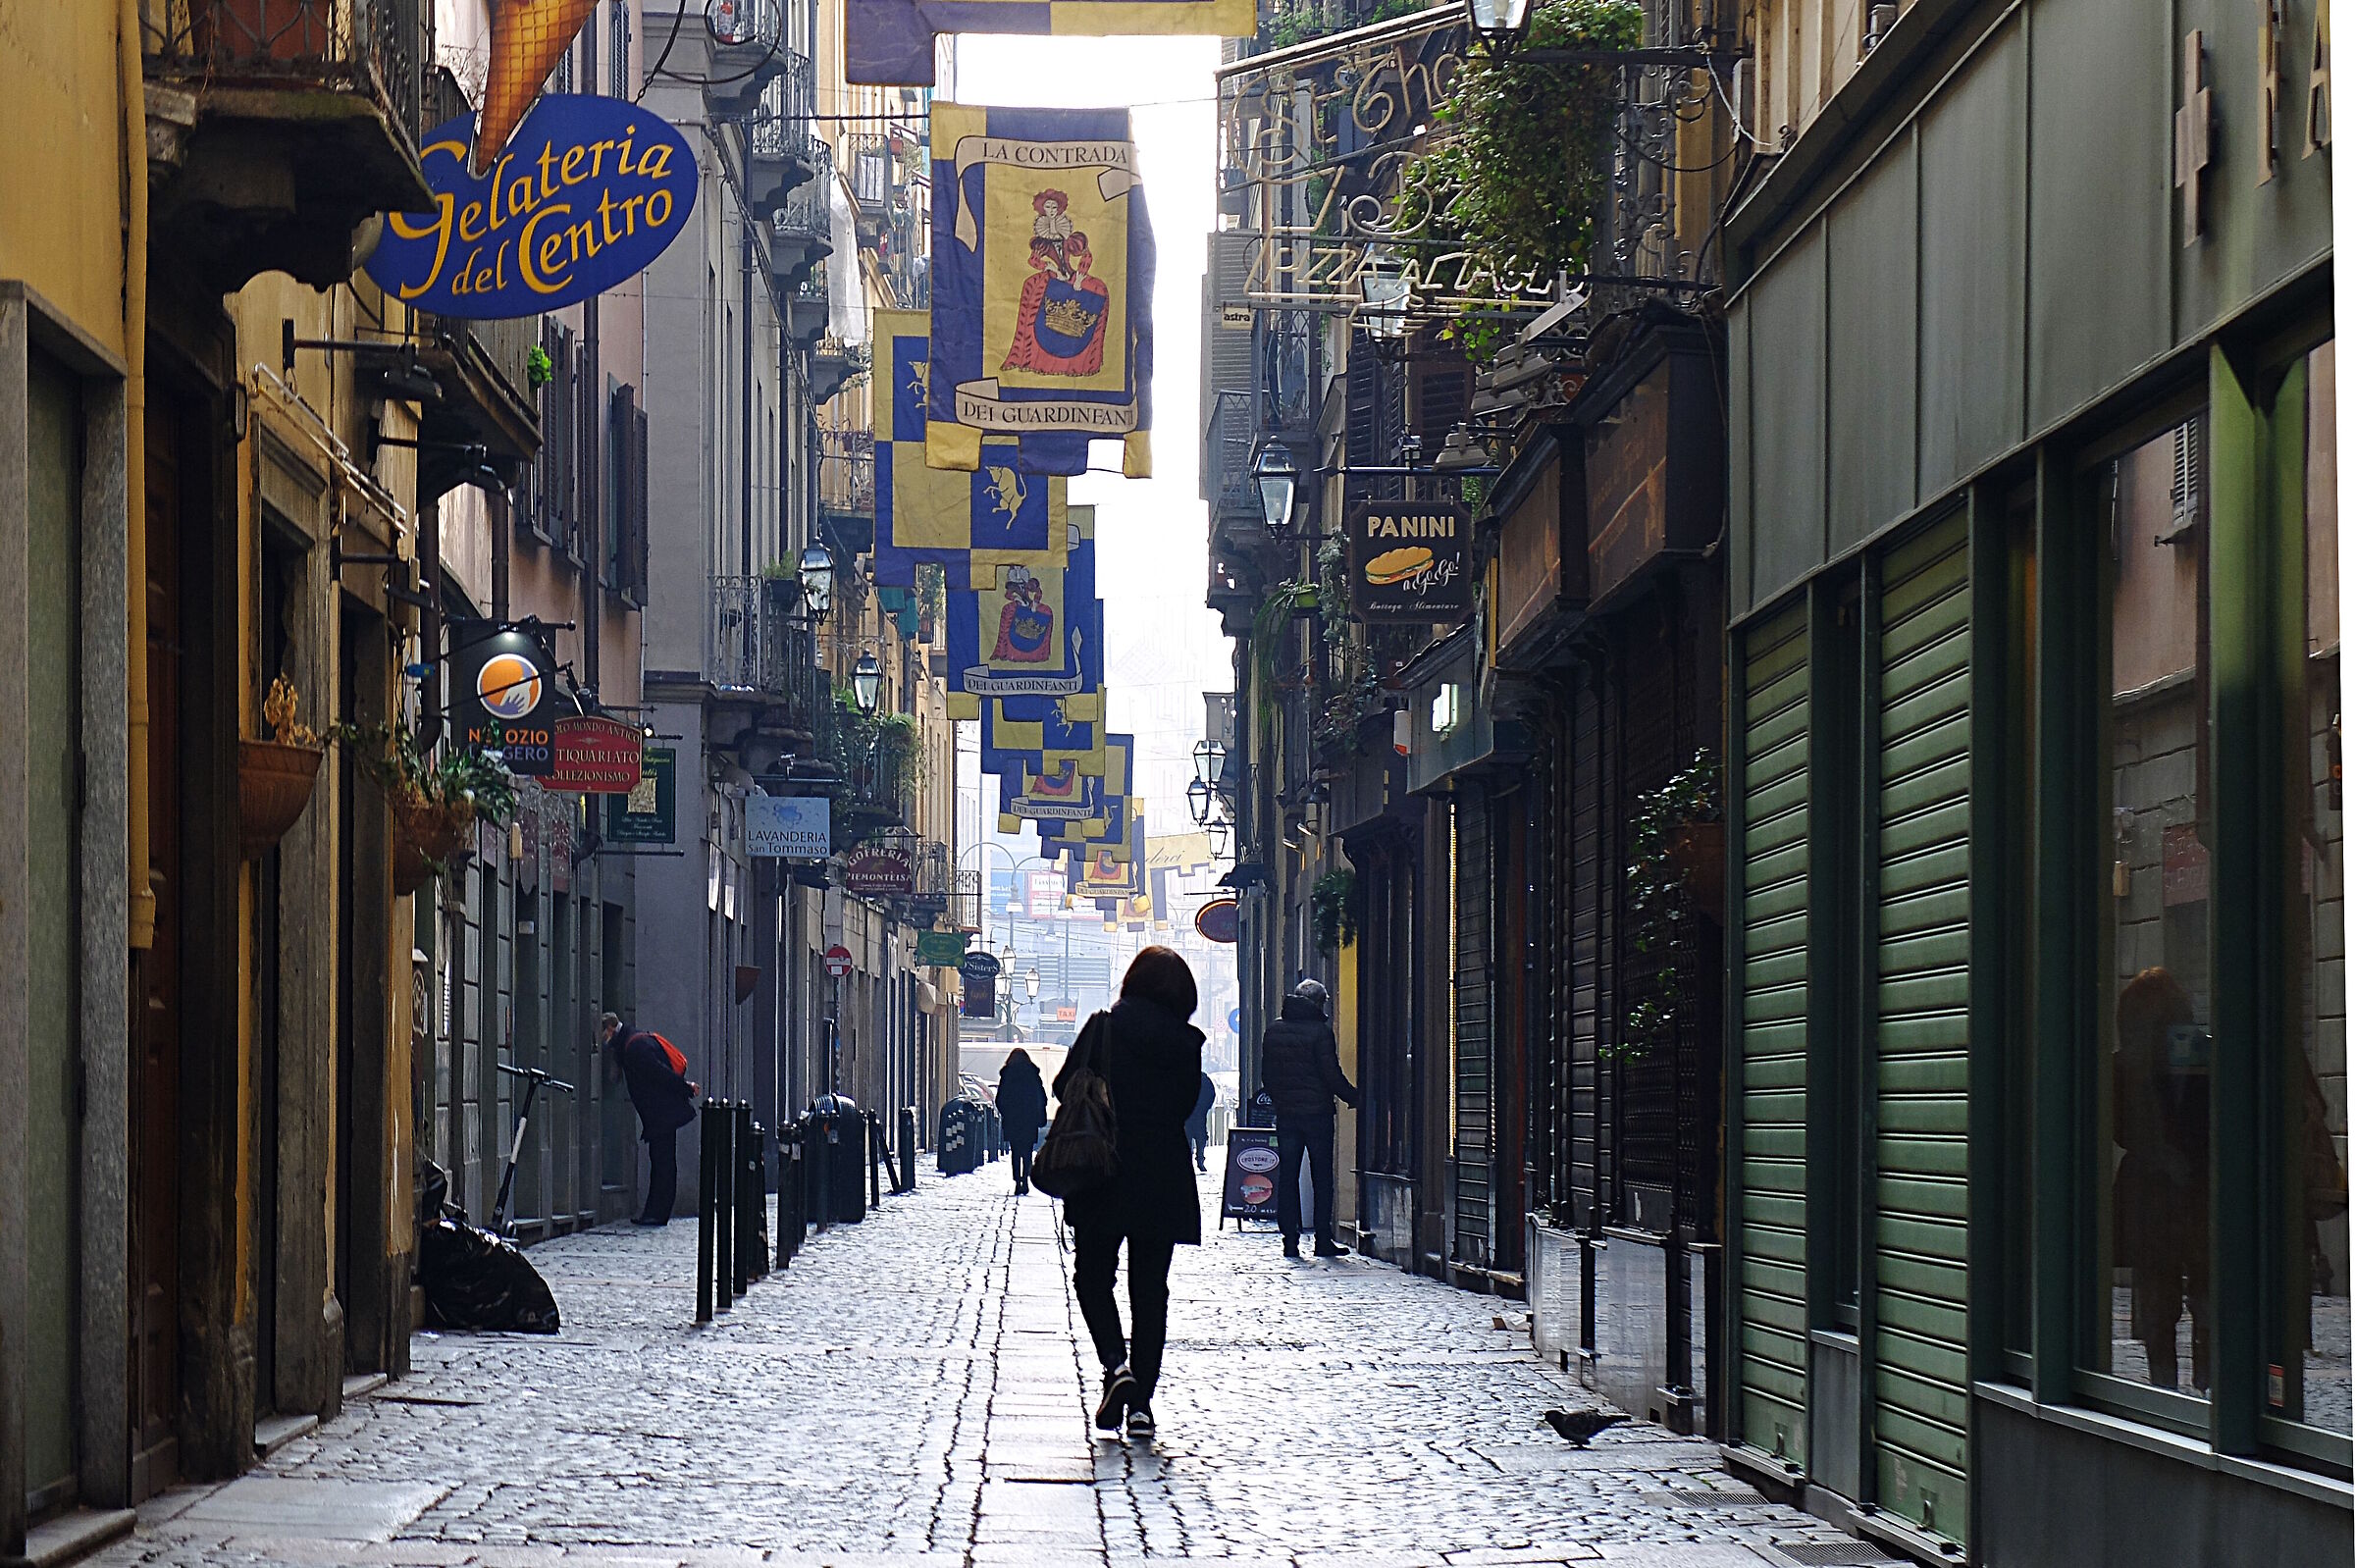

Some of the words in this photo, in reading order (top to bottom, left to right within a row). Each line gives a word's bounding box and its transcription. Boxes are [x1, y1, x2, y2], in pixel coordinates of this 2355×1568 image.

[982, 142, 1010, 162] LA
[1015, 145, 1128, 165] CONTRADA
[389, 125, 674, 299] Gelateria
[451, 239, 509, 295] del
[518, 188, 673, 294] Centro
[1224, 313, 1251, 322] astra
[964, 401, 995, 423] DEI
[1367, 516, 1455, 538] PANINI
[968, 678, 987, 691] DEI
[991, 680, 1077, 691] GUARDINFANTI
[468, 727, 549, 746] NOZIO
[573, 721, 605, 732] MONDO
[607, 724, 640, 743] ANTICO
[748, 830, 827, 843] LAVANDERIA
[748, 844, 765, 853] San
[766, 842, 828, 855] Tommaso
